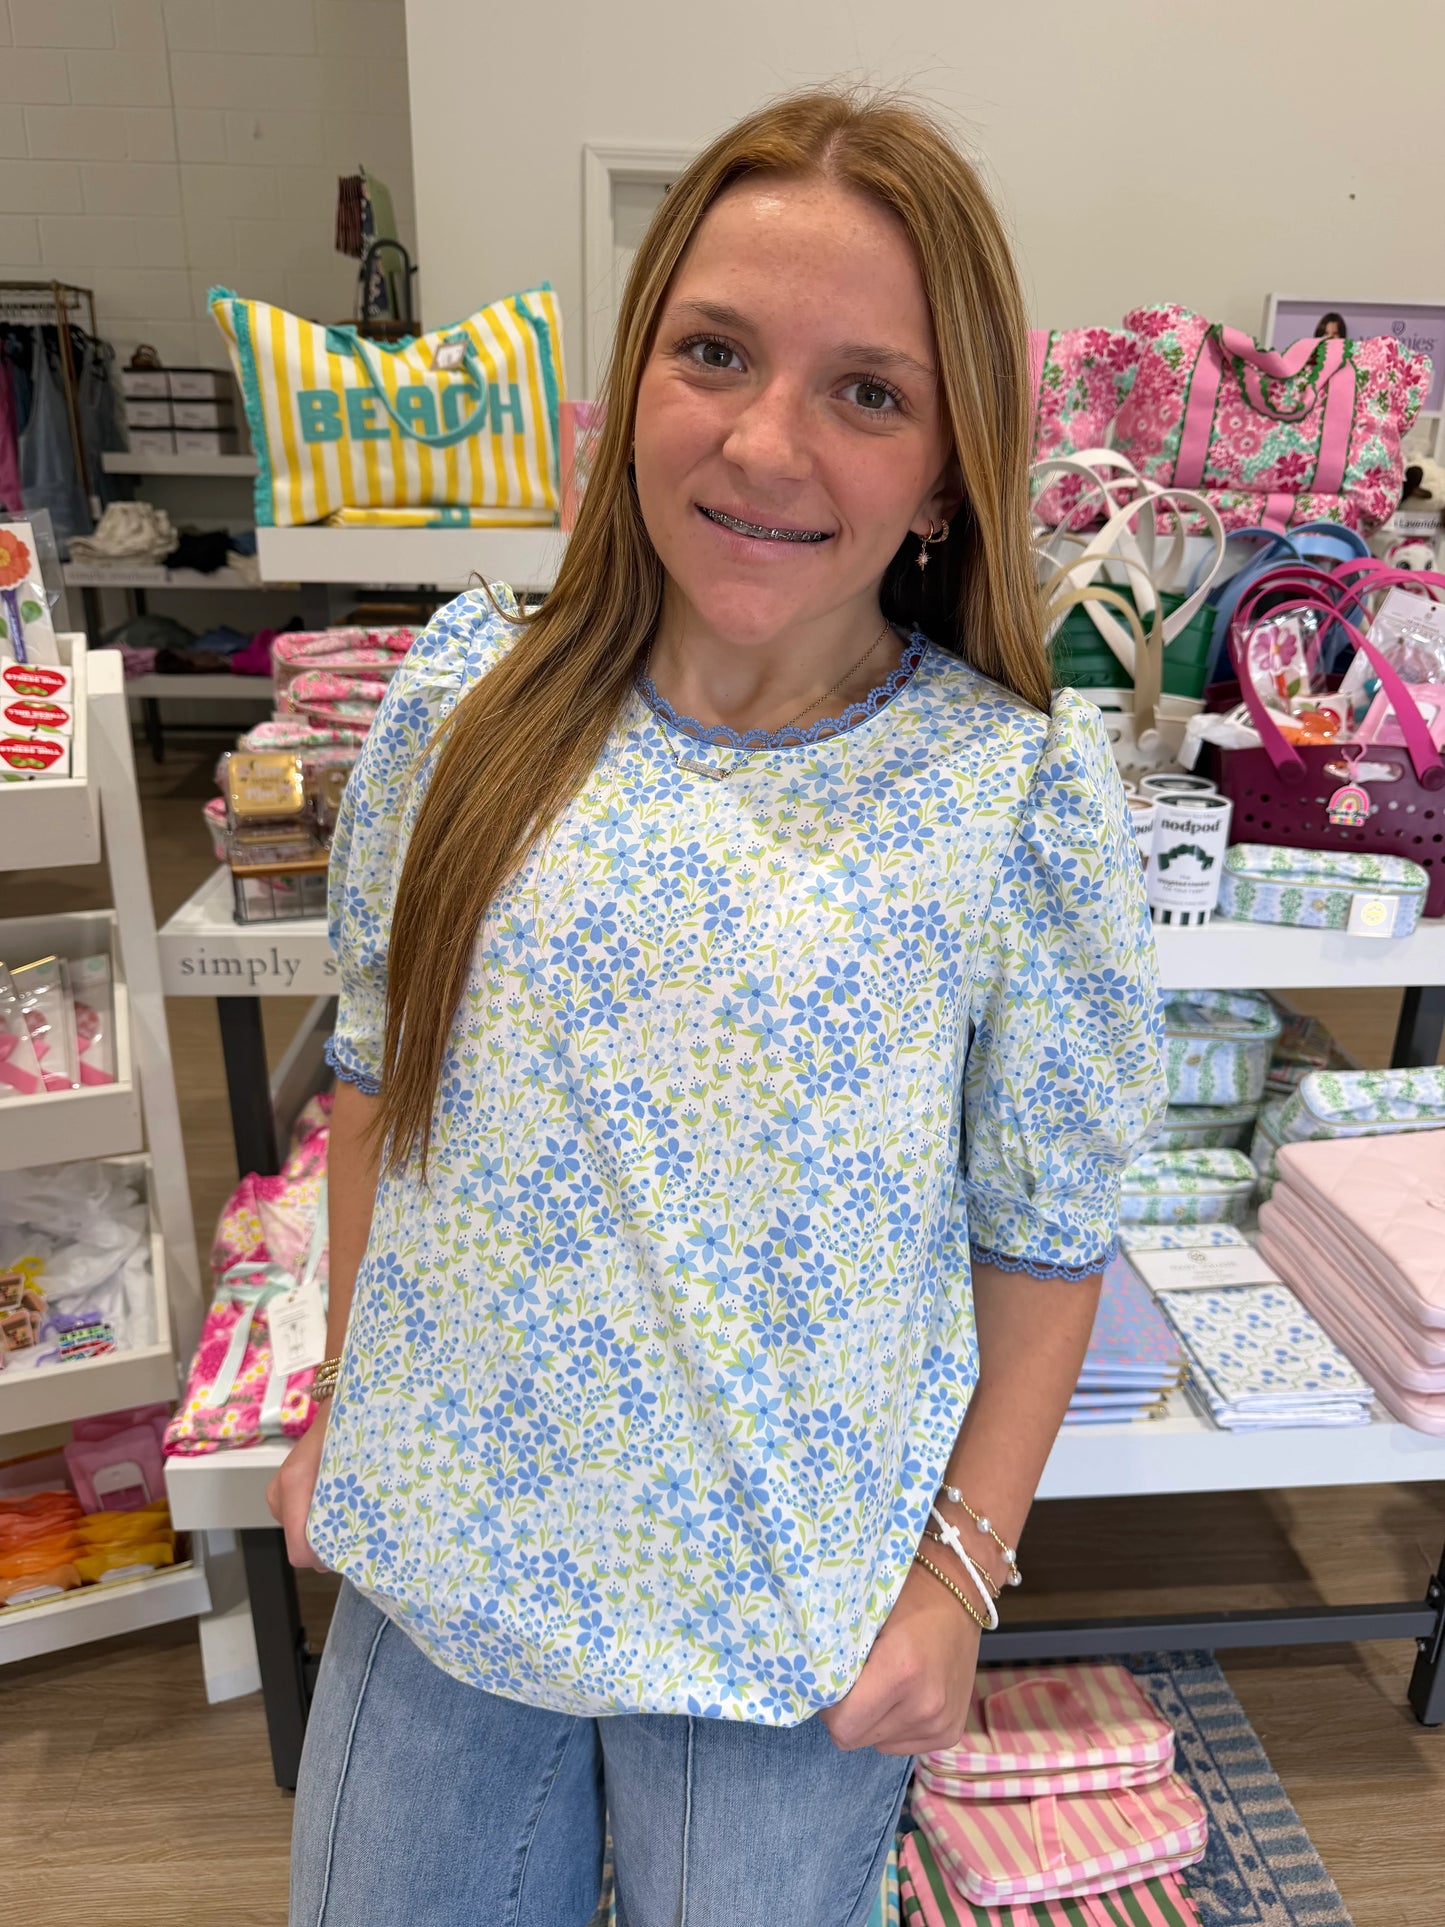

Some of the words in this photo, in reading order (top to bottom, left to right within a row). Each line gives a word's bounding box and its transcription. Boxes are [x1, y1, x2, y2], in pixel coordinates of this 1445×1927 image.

[297, 383, 525, 443] BEACH
[1161, 819, 1220, 835] nodpod
[180, 947, 300, 987] simply
